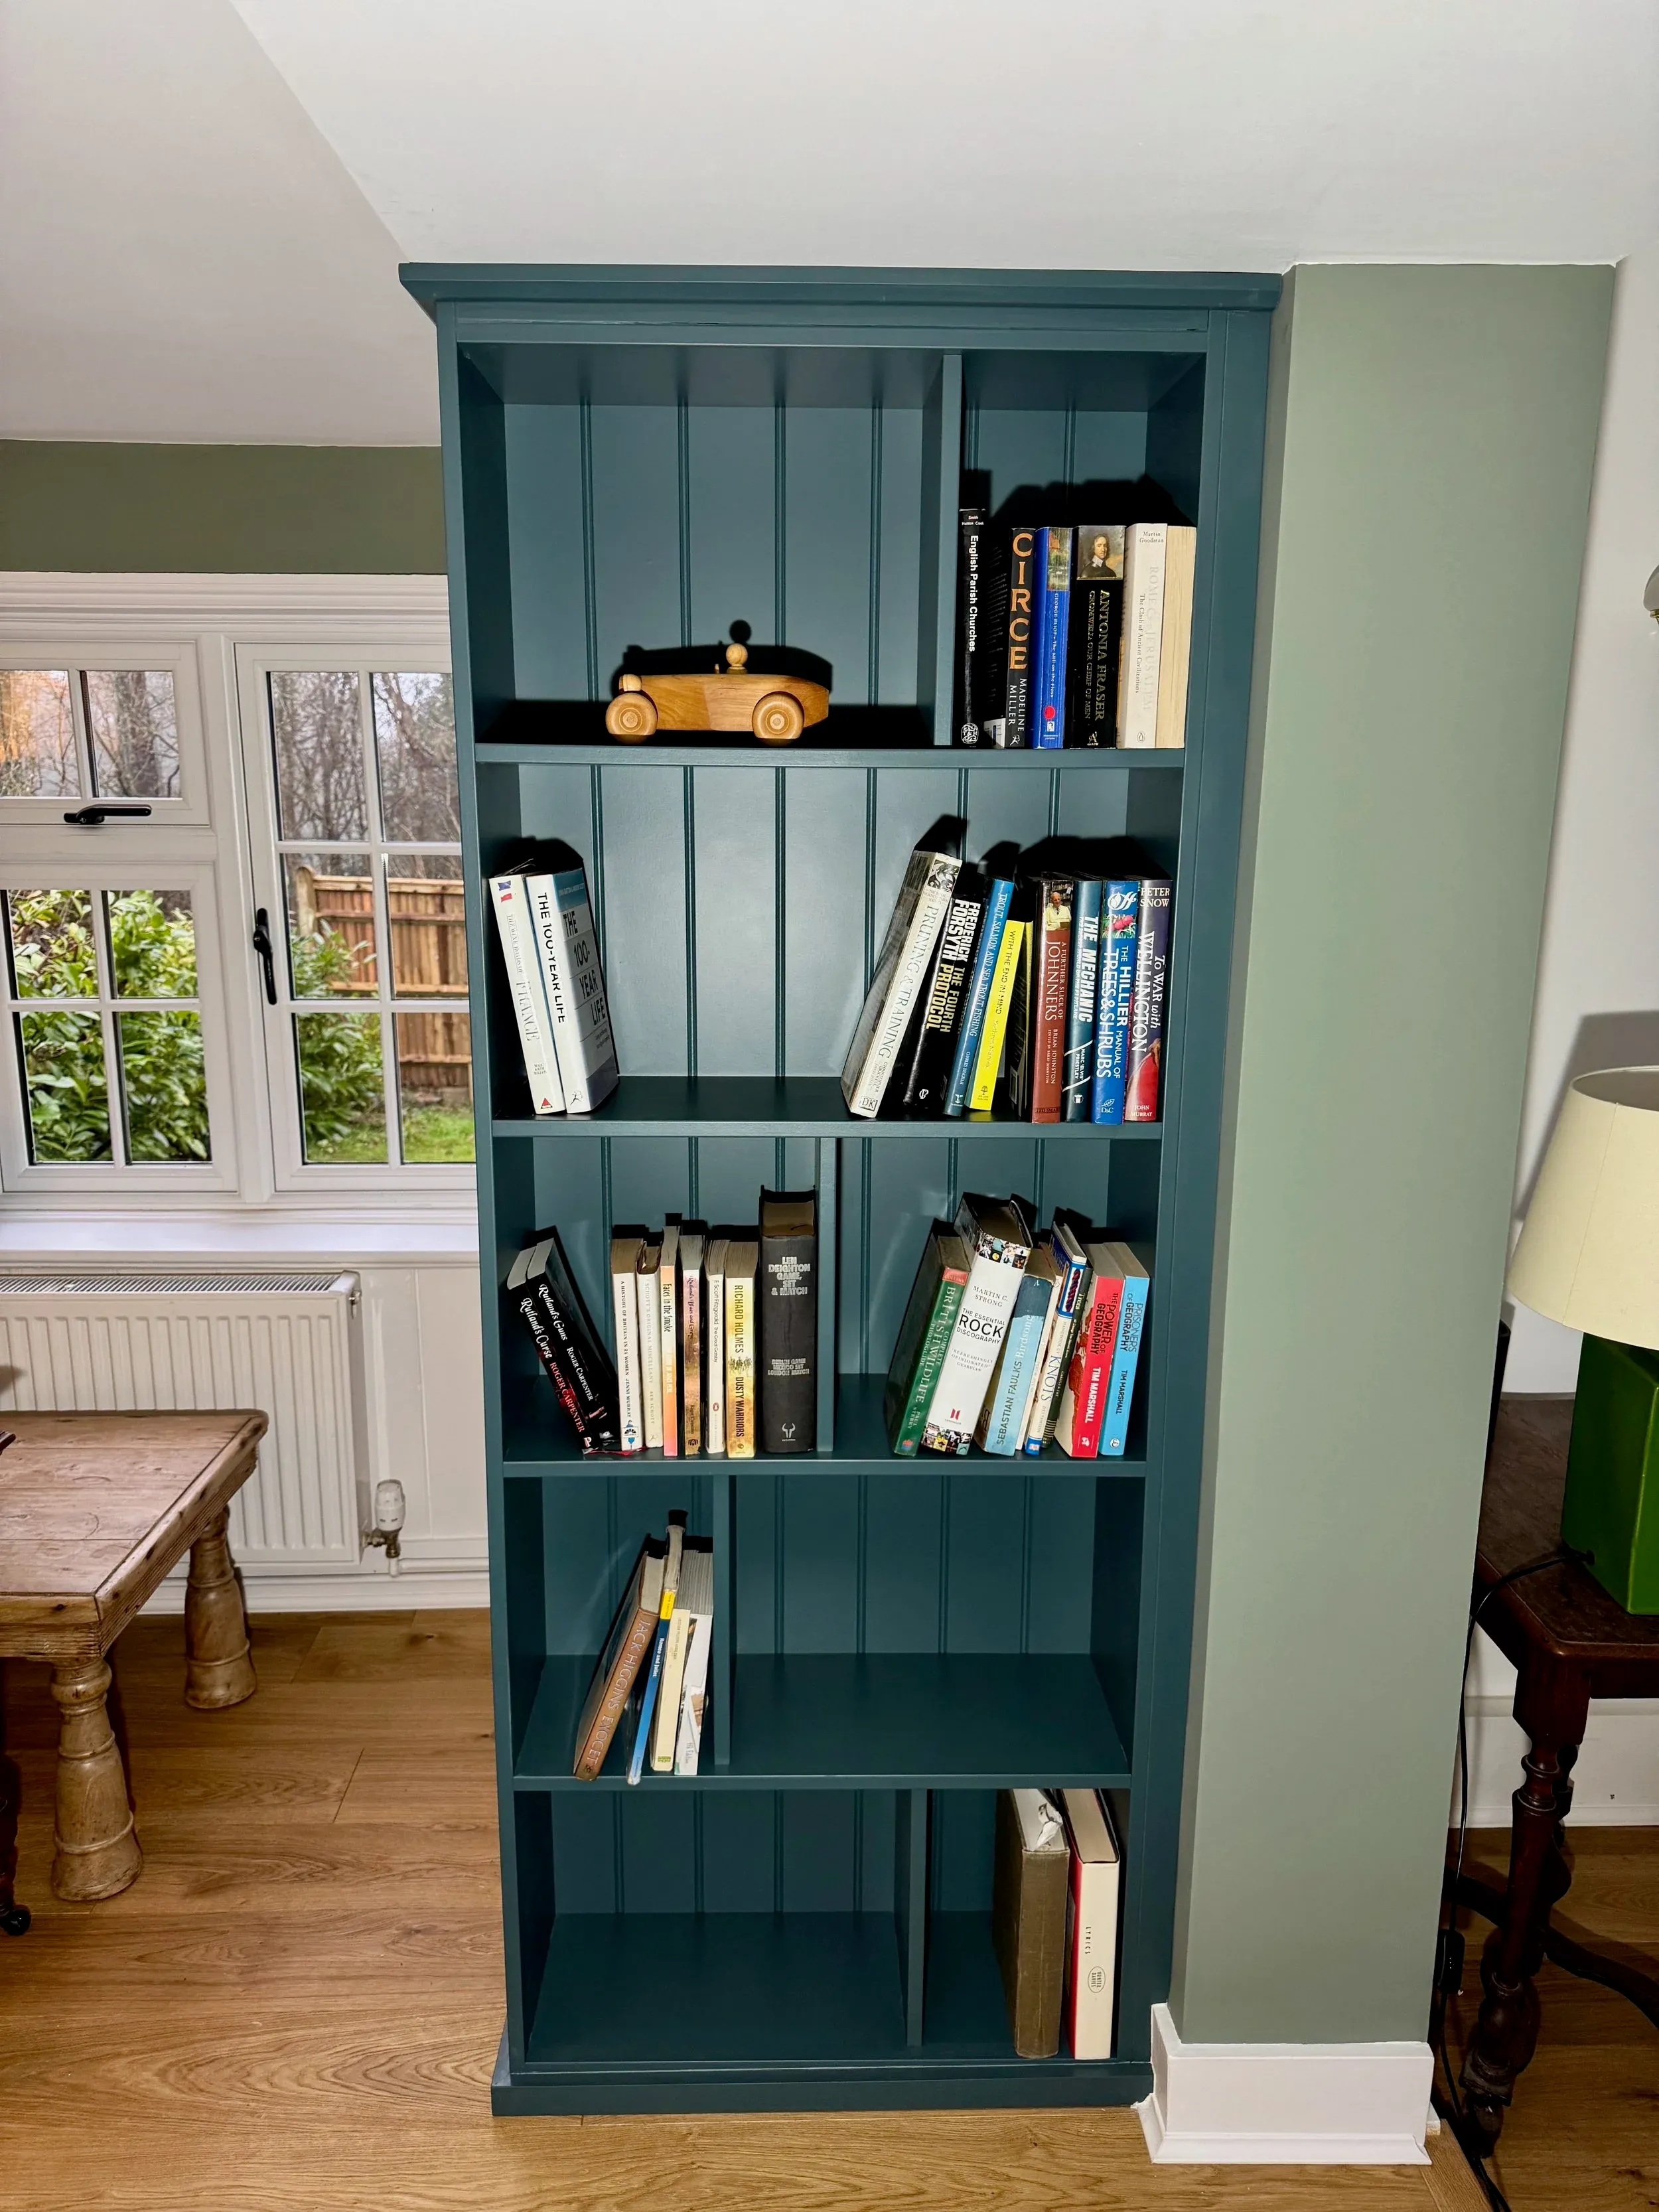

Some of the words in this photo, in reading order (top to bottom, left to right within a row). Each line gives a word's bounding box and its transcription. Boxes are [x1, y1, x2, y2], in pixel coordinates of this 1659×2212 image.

[968, 535, 979, 571] English
[969, 573, 978, 604] Parish
[1009, 532, 1033, 670] CIRCE
[968, 606, 978, 652] Churches
[1097, 589, 1110, 661] ANTONIA
[1007, 685, 1017, 725] MILLER
[1017, 678, 1028, 731] MADELINE
[1085, 687, 1092, 699] OF
[1095, 664, 1107, 721] FRASER
[538, 892, 551, 919] THE
[1139, 898, 1170, 908] SNOW
[1140, 887, 1171, 897] PETER
[906, 904, 940, 974] PRUNING
[942, 899, 968, 961] FORSYTH
[956, 901, 981, 962] FREDERICK
[989, 921, 1002, 950] SALMON
[1007, 930, 1017, 951] WITH
[1084, 917, 1099, 942] THE
[542, 922, 561, 992] 100-YEAR
[986, 951, 995, 966] AND
[1120, 945, 1129, 962] THE
[1154, 954, 1166, 970] To
[899, 974, 910, 988] &
[952, 966, 966, 987] THE
[983, 966, 991, 982] SEA
[1001, 967, 1009, 983] END
[1045, 940, 1061, 1021] JOHNNERS
[1078, 946, 1097, 1023] MECHANIC
[1102, 948, 1119, 996] TREES
[1153, 971, 1165, 1002] WAR
[926, 963, 954, 1029] PROTOCOL
[977, 982, 989, 1007] TROUT
[995, 995, 1005, 1015] MIND
[999, 984, 1005, 994] IN
[1116, 966, 1131, 1027] HILLIER
[1131, 930, 1155, 1053] WELLINGTON
[516, 981, 540, 1041] FRANCE
[554, 995, 566, 1023] LIFE
[877, 988, 914, 1060] TRAINING
[939, 990, 960, 1033] FOURTH
[969, 1007, 983, 1037] FISHING
[1058, 1010, 1064, 1019] OF
[1150, 1004, 1161, 1030] with
[1096, 1011, 1115, 1078] SHRUBS
[1115, 1030, 1124, 1066] MANUAL
[1114, 1068, 1120, 1079] OF
[768, 1263, 811, 1272] DEIGHTON
[776, 1272, 802, 1281] GAME,
[782, 1256, 798, 1265] LEN
[663, 1284, 672, 1299] Faces
[734, 1284, 744, 1320] RICHARD
[780, 1287, 808, 1295] MATCH
[973, 1286, 1001, 1299] MARTIN
[975, 1293, 1003, 1307] STRONG
[1074, 1293, 1086, 1310] Trees
[1110, 1292, 1119, 1305] THE
[664, 1313, 673, 1333] Smoke
[932, 1286, 956, 1344] BRITISH
[958, 1313, 1004, 1339] ROCK
[962, 1307, 974, 1317] THE
[974, 1313, 1006, 1326] ESSENTIAL
[1089, 1303, 1106, 1355] GEOGRAPHY
[1100, 1304, 1117, 1345] POWER
[1119, 1302, 1135, 1352] GEOGRAPHY
[1127, 1303, 1143, 1353] PRISONERS
[538, 1284, 559, 1320] Rutland's
[553, 1320, 568, 1341] Guns
[566, 1347, 579, 1368] ROGER
[575, 1367, 594, 1402] CARPENTER
[735, 1321, 744, 1354] HOLMES
[919, 1323, 936, 1367] PHOTOGUIDE
[935, 1331, 950, 1366] COMPLETE
[956, 1327, 1001, 1345] DISCOGRAPHY
[1015, 1314, 1034, 1359] Birdsong
[1099, 1344, 1107, 1353] OF
[520, 1297, 545, 1335] Rutland's
[536, 1335, 553, 1359] Curse
[549, 1362, 565, 1391] ROGER
[561, 1388, 585, 1433] CARPENTER
[915, 1343, 938, 1403] WILDLIFE
[1041, 1355, 1062, 1402] KNOTS
[1092, 1366, 1102, 1382] TIM
[735, 1376, 744, 1398] DUSTY
[996, 1396, 1014, 1445] SEBASTIAN
[1007, 1361, 1022, 1395] FAULKS
[1084, 1383, 1100, 1424] MARSHALL
[1115, 1382, 1127, 1414] MARSHALL
[735, 1400, 745, 1438] WARRIORS
[630, 1619, 651, 1652] JACK
[607, 1653, 638, 1710] HIGGINS
[587, 1716, 614, 1765] EXOCET
